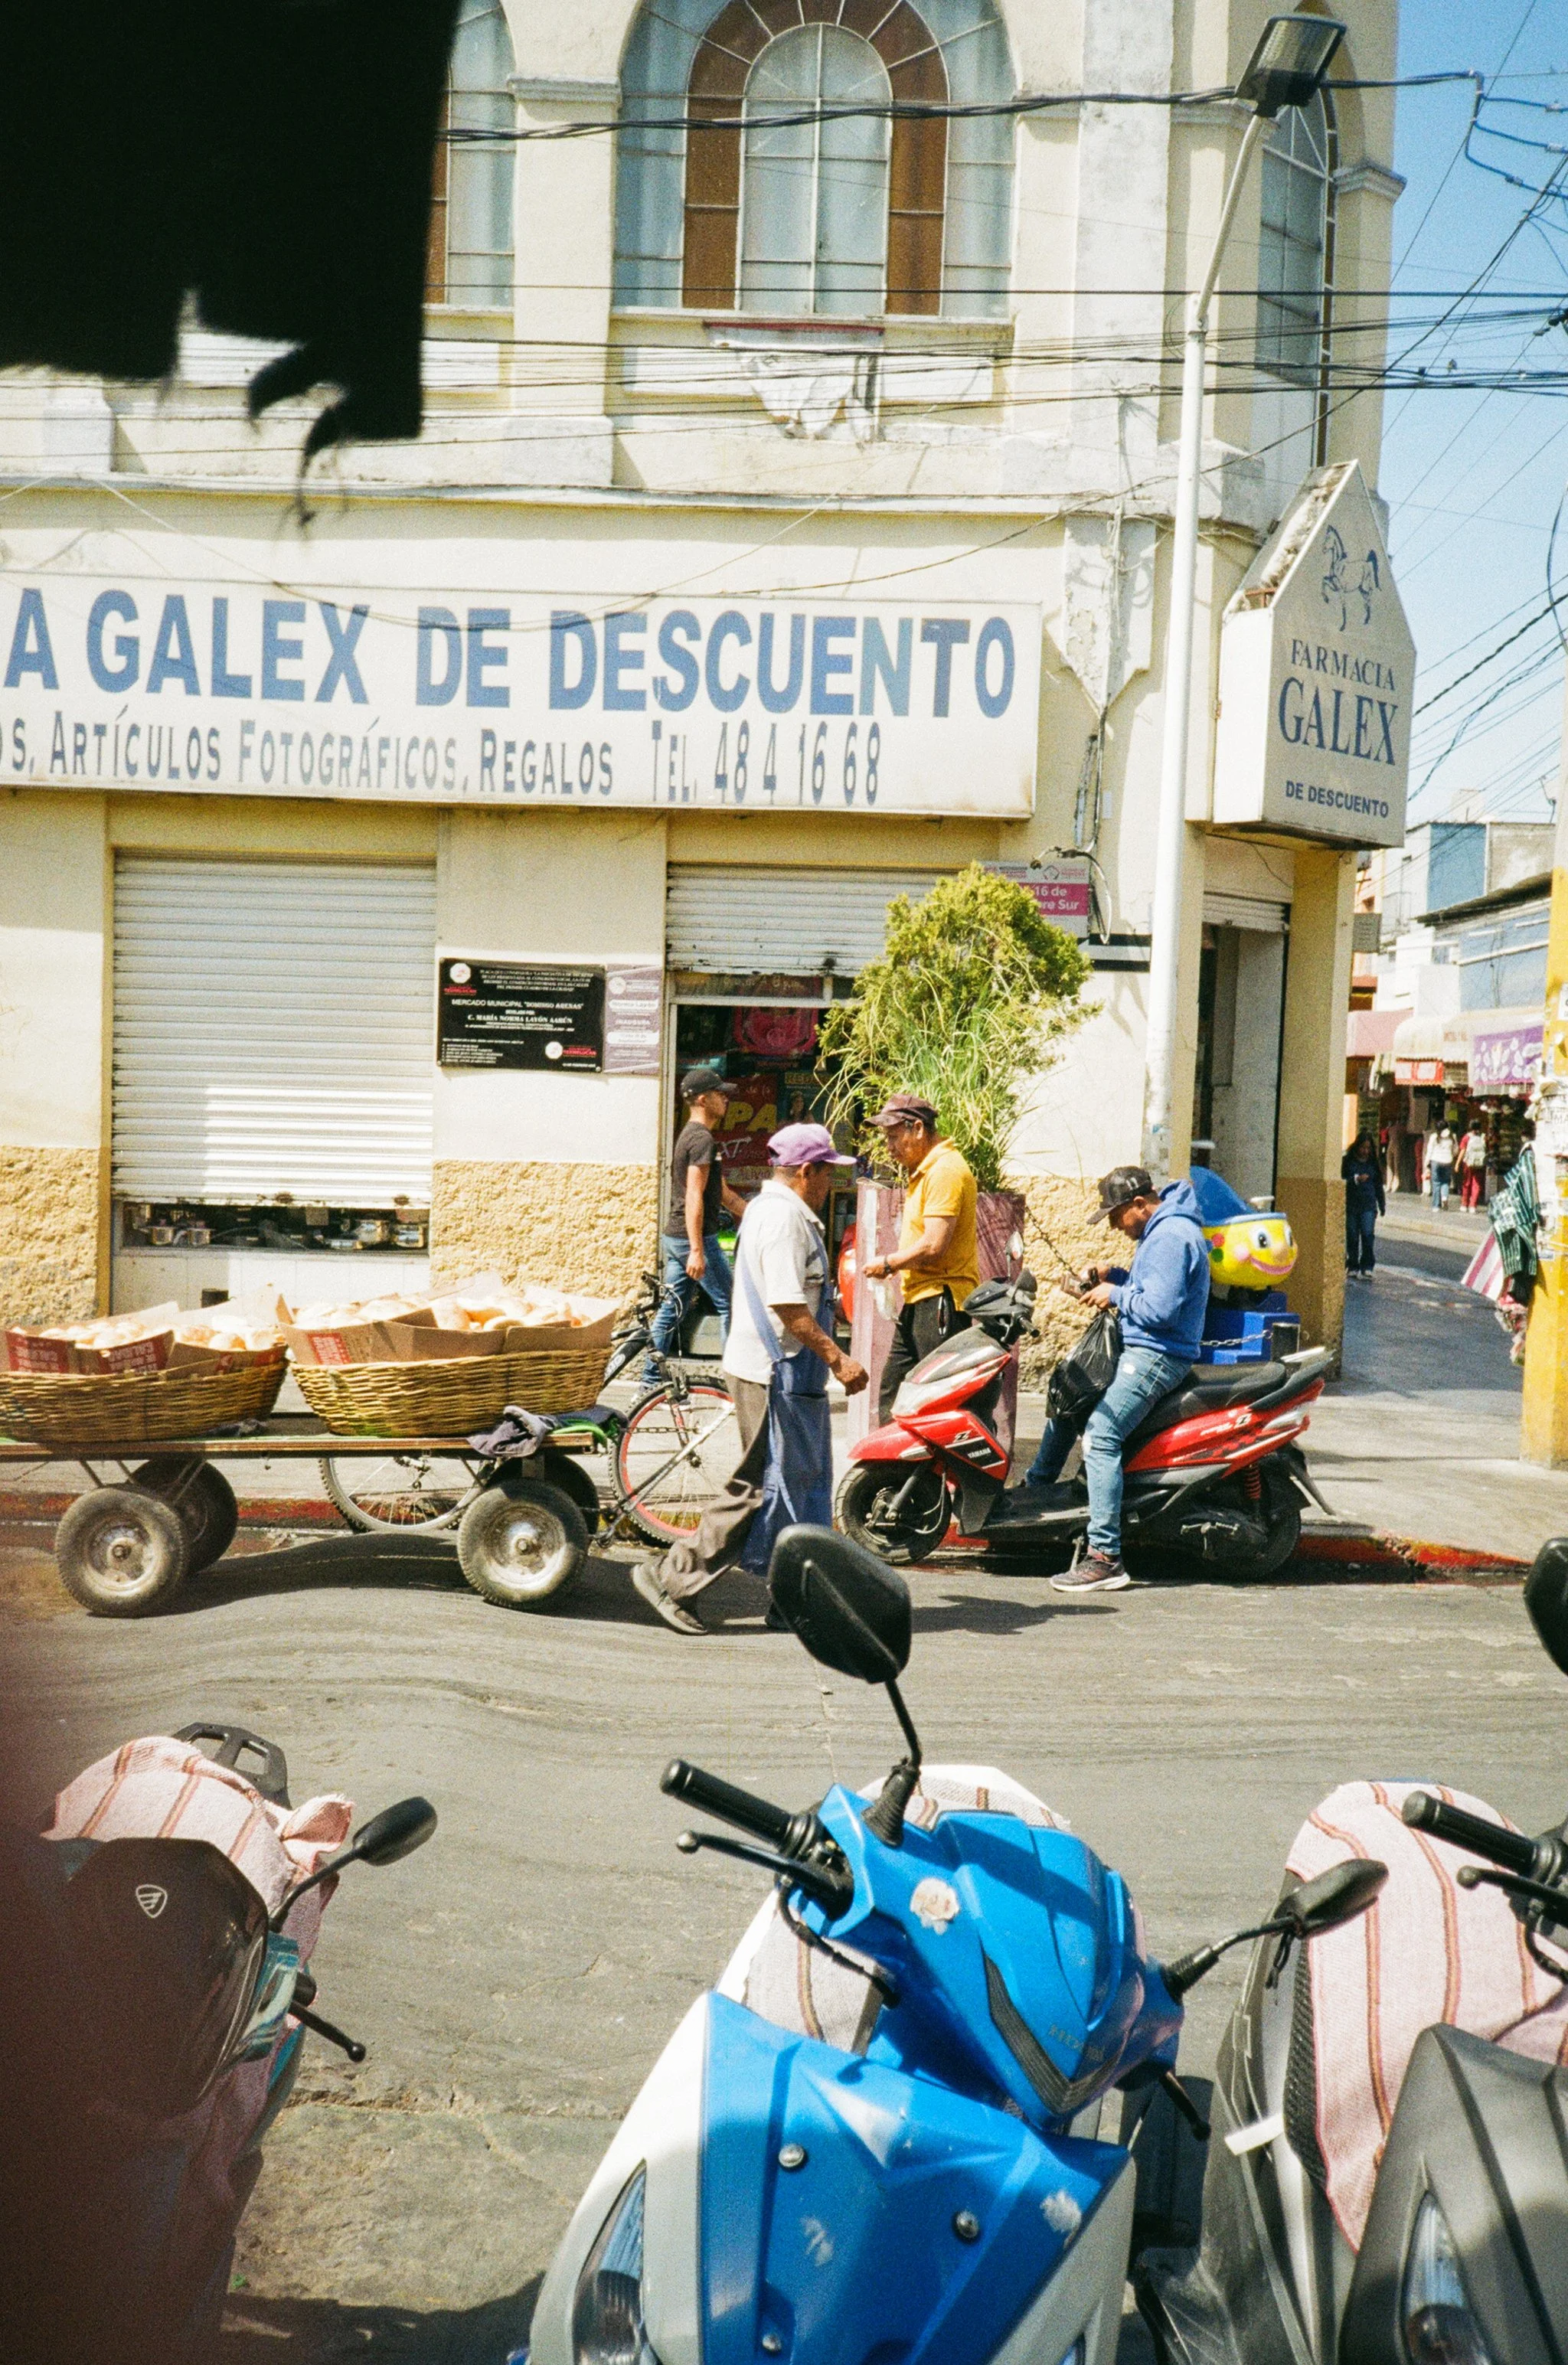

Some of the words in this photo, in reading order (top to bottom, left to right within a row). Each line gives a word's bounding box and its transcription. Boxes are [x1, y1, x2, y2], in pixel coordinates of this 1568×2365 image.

[4, 589, 59, 691] A
[86, 590, 370, 704] GALEX
[416, 606, 511, 708] DE
[548, 610, 1015, 719] DESCUENTO
[1291, 639, 1395, 691] FARMACIA
[1279, 677, 1398, 766] GALEX
[0, 717, 34, 774] S,
[49, 704, 222, 782] ARTÍCULOS
[238, 716, 469, 794] FOTOGRÁFICOS,
[480, 729, 612, 795] REGALOS
[1285, 779, 1304, 800] DE
[1308, 785, 1389, 818] DESCUENTO
[1035, 886, 1048, 897] 16
[1051, 886, 1067, 897] de
[1057, 900, 1079, 910] Sur
